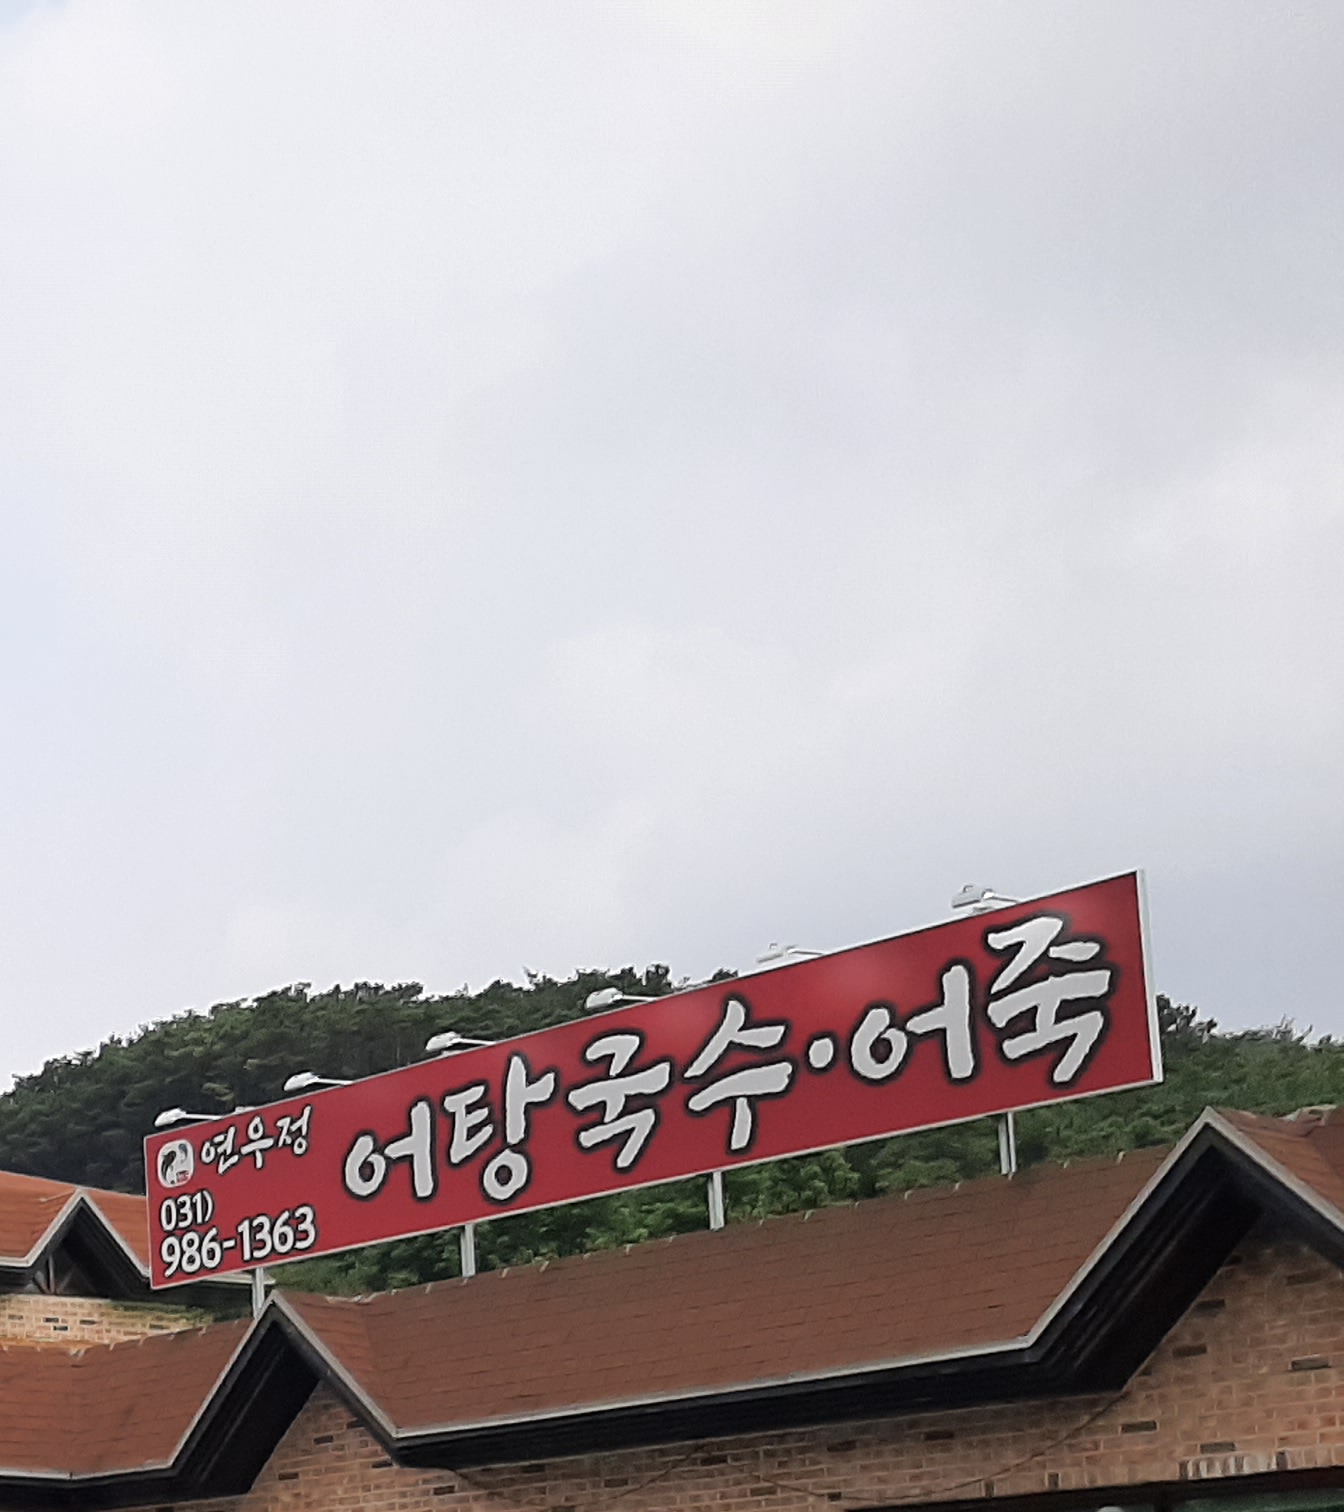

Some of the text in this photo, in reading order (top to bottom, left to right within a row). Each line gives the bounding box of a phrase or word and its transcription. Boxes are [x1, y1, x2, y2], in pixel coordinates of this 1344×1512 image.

[200, 1104, 312, 1175] 연우정
[160, 1189, 214, 1232] 031)
[160, 1204, 317, 1278] 986-1363
